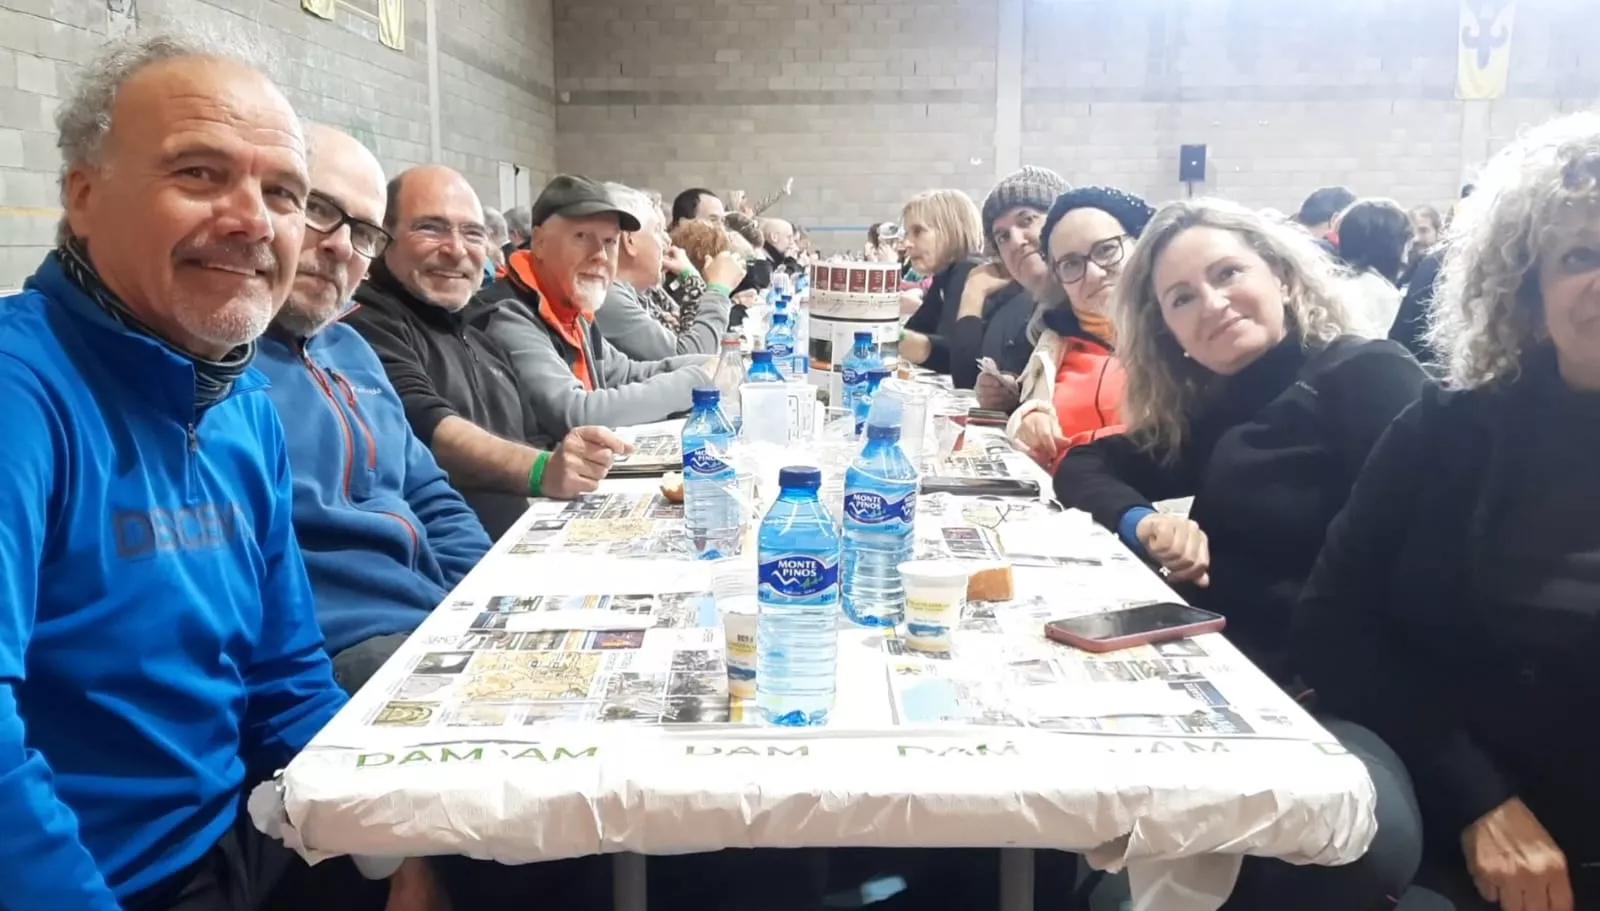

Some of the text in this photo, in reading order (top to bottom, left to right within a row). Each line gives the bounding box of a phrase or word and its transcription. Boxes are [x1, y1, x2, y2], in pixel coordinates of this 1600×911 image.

[853, 494, 881, 503] MONTE
[856, 501, 882, 510] PINOS
[777, 560, 818, 569] MONTE
[782, 568, 817, 577] PINOS
[356, 747, 484, 768] DAM
[500, 746, 598, 763] AM
